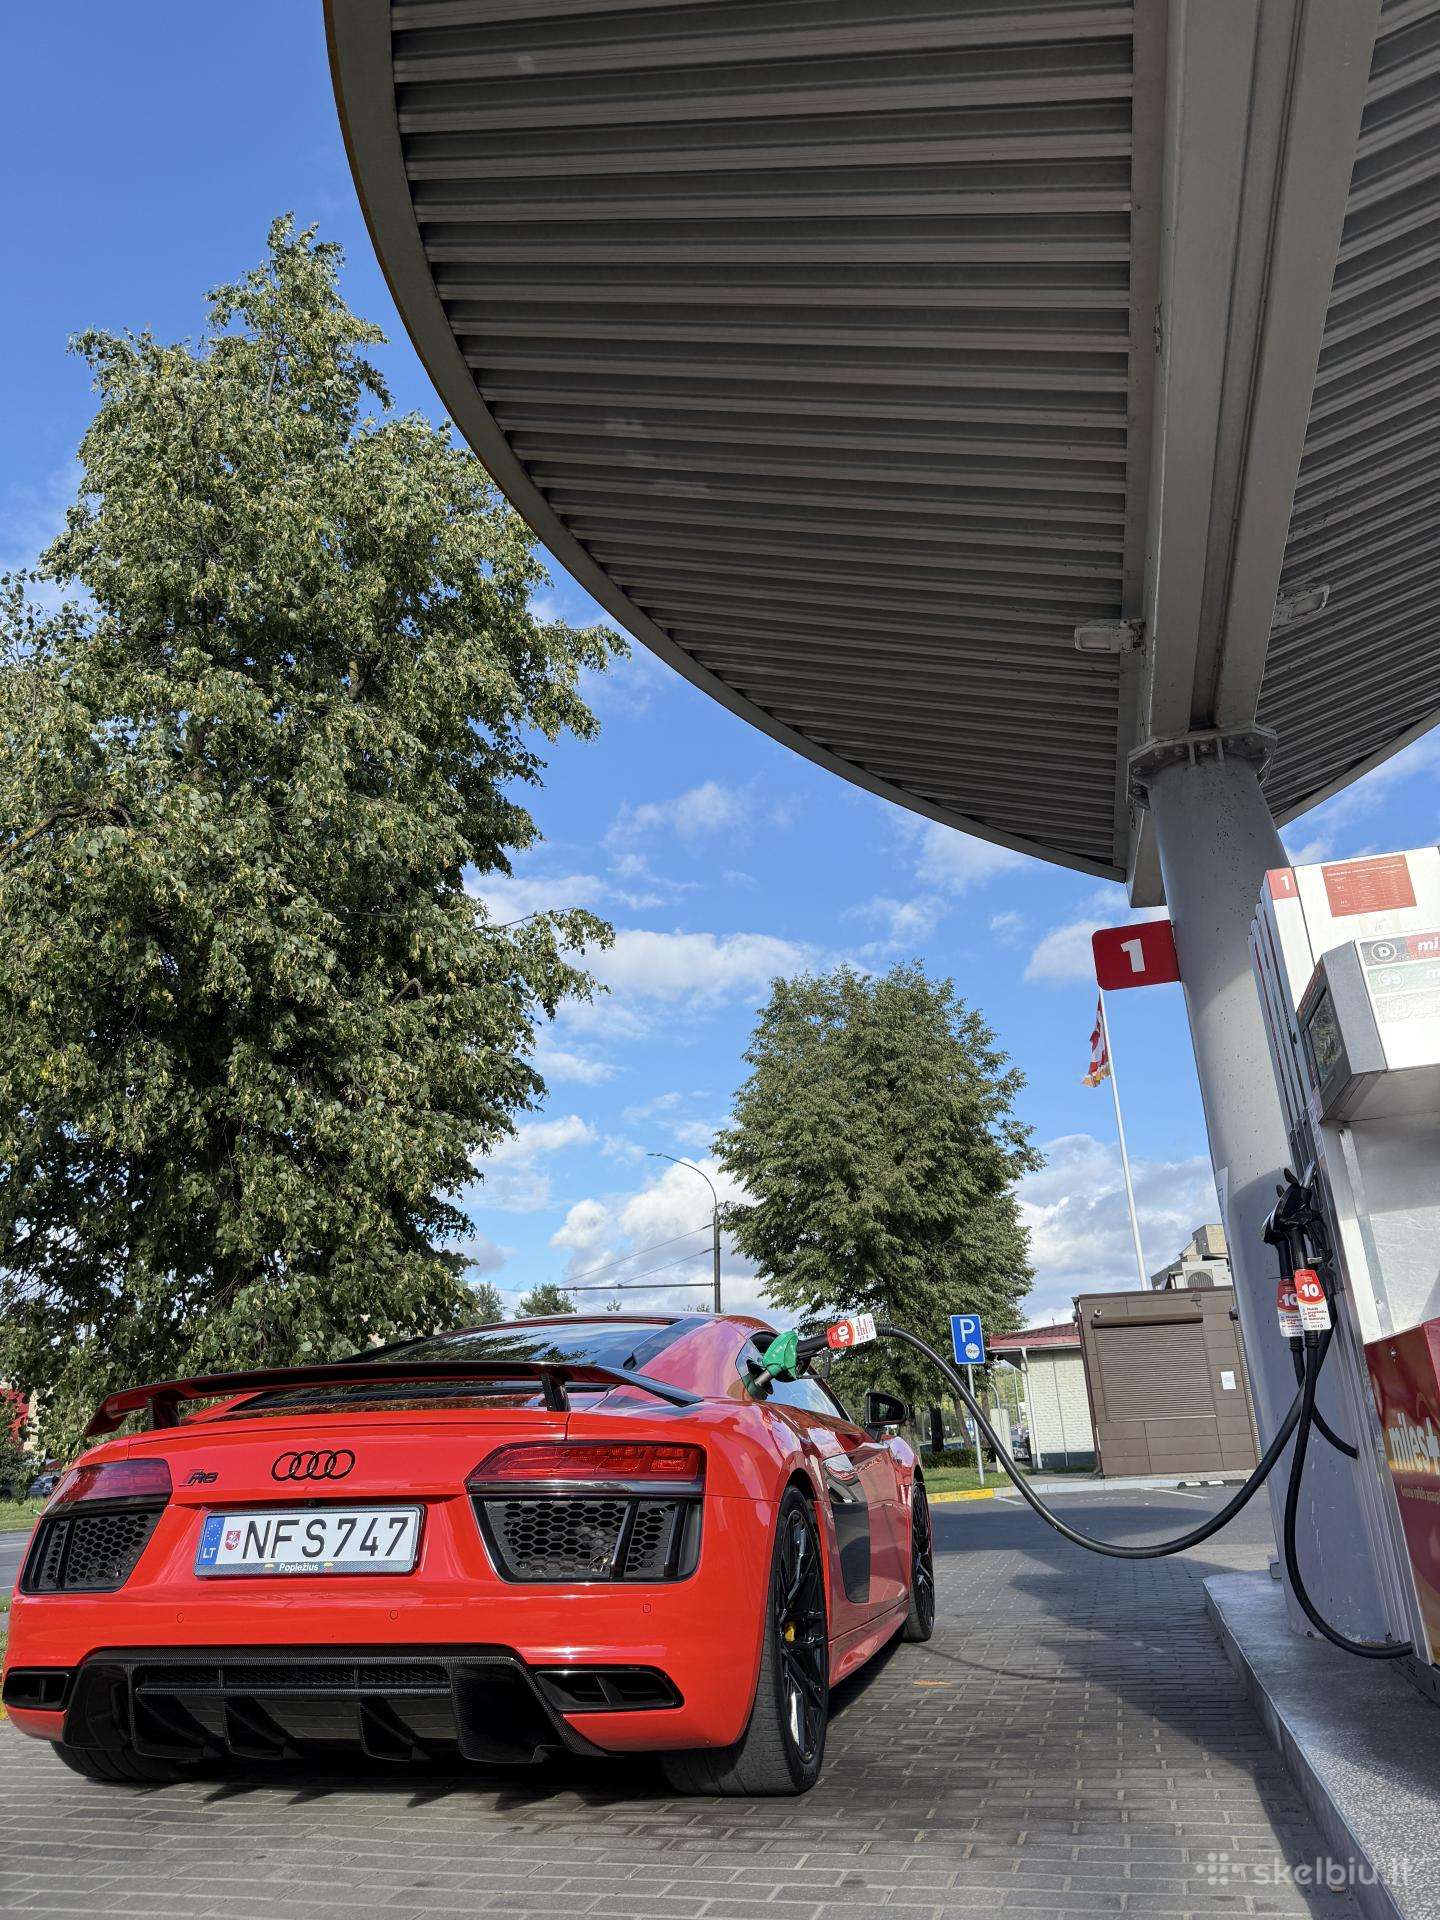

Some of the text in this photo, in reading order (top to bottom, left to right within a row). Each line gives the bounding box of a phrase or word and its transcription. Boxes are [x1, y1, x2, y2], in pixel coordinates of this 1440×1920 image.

[1280, 874, 1291, 890] 1
[1120, 938, 1146, 973] 1
[960, 1318, 976, 1343] P
[202, 1547, 217, 1559] LT
